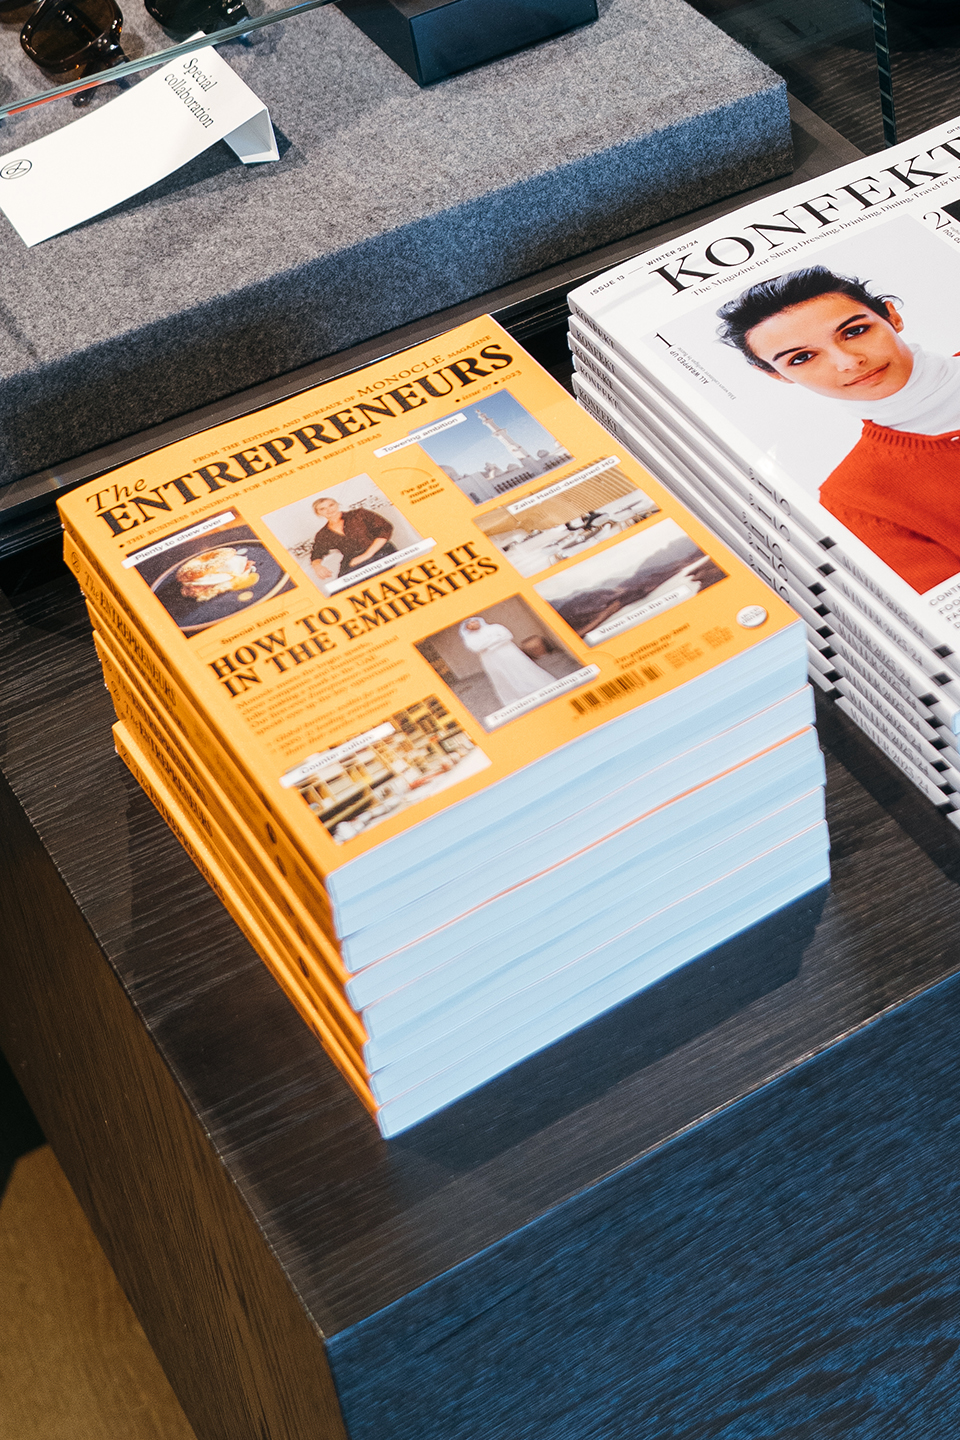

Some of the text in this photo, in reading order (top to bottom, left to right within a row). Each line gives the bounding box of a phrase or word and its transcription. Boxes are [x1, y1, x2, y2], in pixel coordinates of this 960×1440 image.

[183, 57, 218, 93] Special
[164, 72, 215, 129] collaboration
[690, 284, 711, 295] The
[710, 264, 756, 287] Magazine
[754, 257, 770, 266] for
[769, 244, 799, 260] Sharp
[797, 226, 840, 247] Dressing,
[838, 209, 881, 229] Drinking,
[880, 195, 914, 212] Dining,
[911, 183, 941, 197] Travel
[922, 211, 952, 230] 2
[587, 280, 616, 295] ISSUE
[645, 251, 676, 265] WINTER
[676, 240, 699, 251] 23/24
[575, 307, 615, 348] KONFEKT
[574, 346, 614, 389] KONFEKT
[576, 330, 616, 373] KONFEKT
[668, 349, 709, 384] ALL WRAPPED UP
[192, 335, 492, 463] FROM THE EDITORS AND BUREAUX OF MONOCLE MAGAZINE
[460, 370, 522, 399] issue 07 2023
[580, 366, 619, 410] KONFEKT
[578, 388, 618, 432] KONFEKT
[97, 344, 514, 538] ENTREPRENEURS
[382, 417, 457, 453] Towering ambition
[86, 478, 148, 512] The
[126, 432, 381, 544] THE BUSINESS HANDBOOK FOR PEOPLE WITH BRIGHT IDEAS
[134, 519, 222, 561] Plenty to chew over
[343, 546, 419, 583] Scenting success
[208, 541, 482, 680] HOW TO MAKE IT
[220, 610, 289, 645] Special Edition
[222, 557, 501, 698] IN THE EMIRATES
[84, 570, 176, 706] The ENTREPRENEURS
